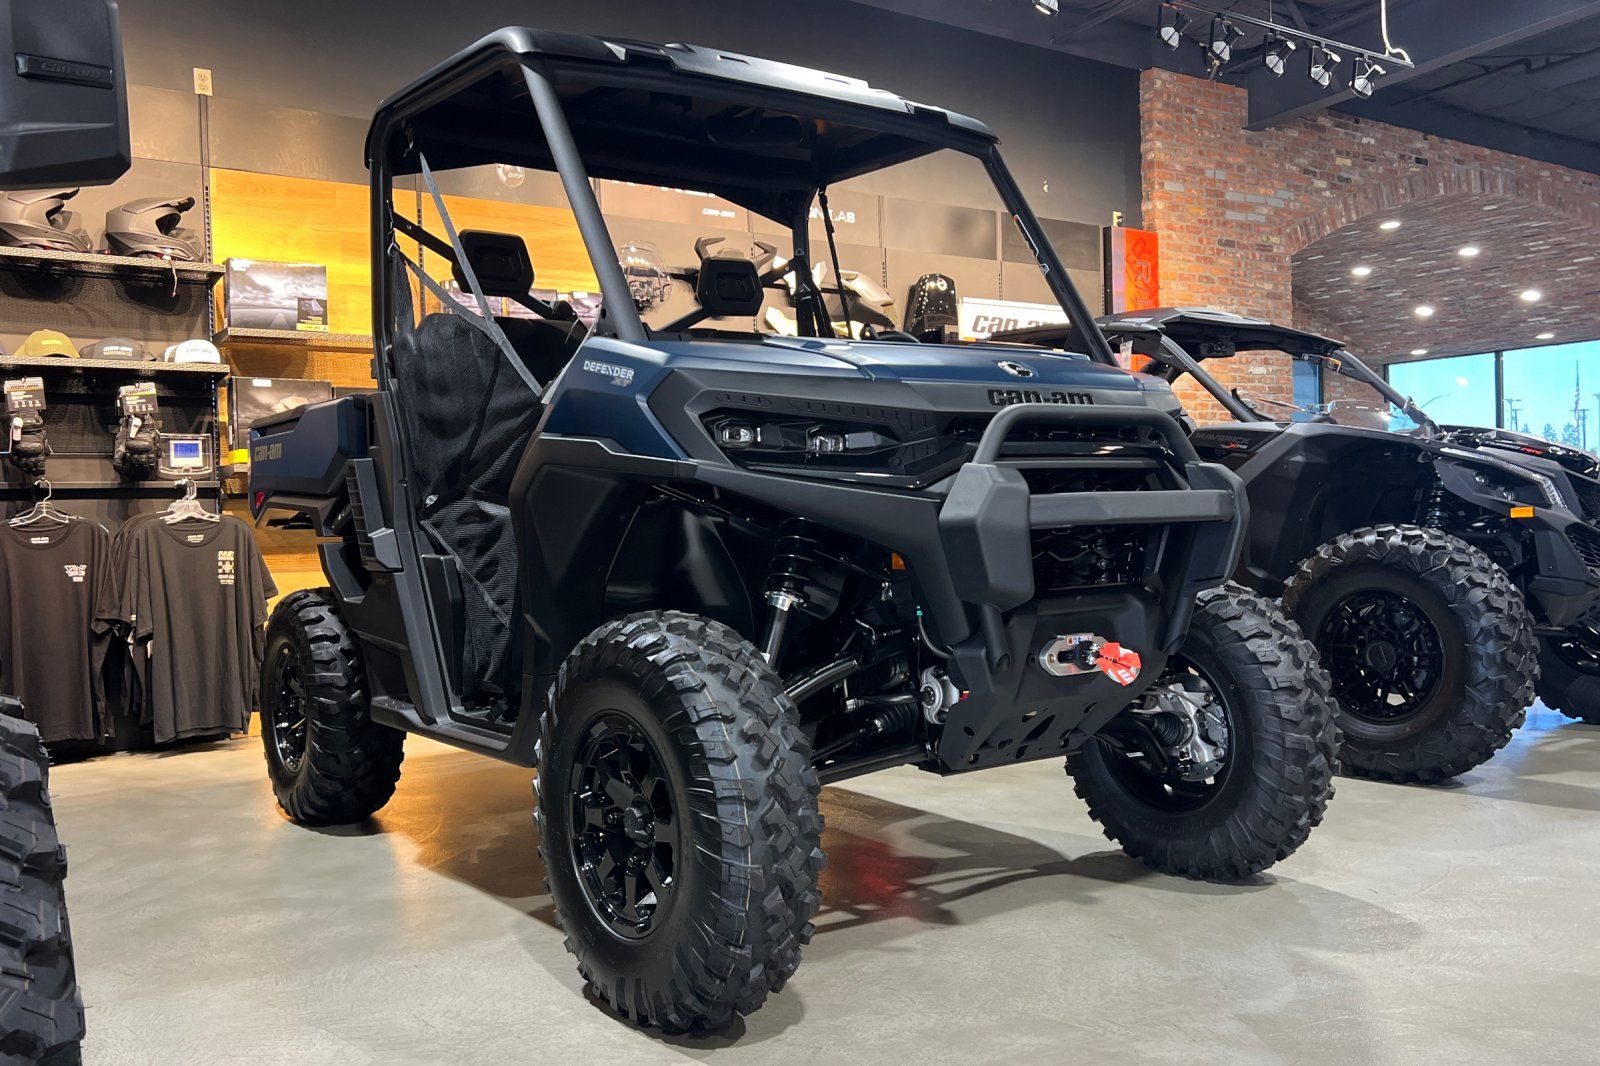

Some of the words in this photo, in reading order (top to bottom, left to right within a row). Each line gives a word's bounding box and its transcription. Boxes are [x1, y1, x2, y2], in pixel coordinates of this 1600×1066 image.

[828, 209, 856, 224] LAB
[583, 360, 635, 380] DEFENDER
[987, 389, 1096, 406] can-am
[254, 443, 282, 461] can-am
